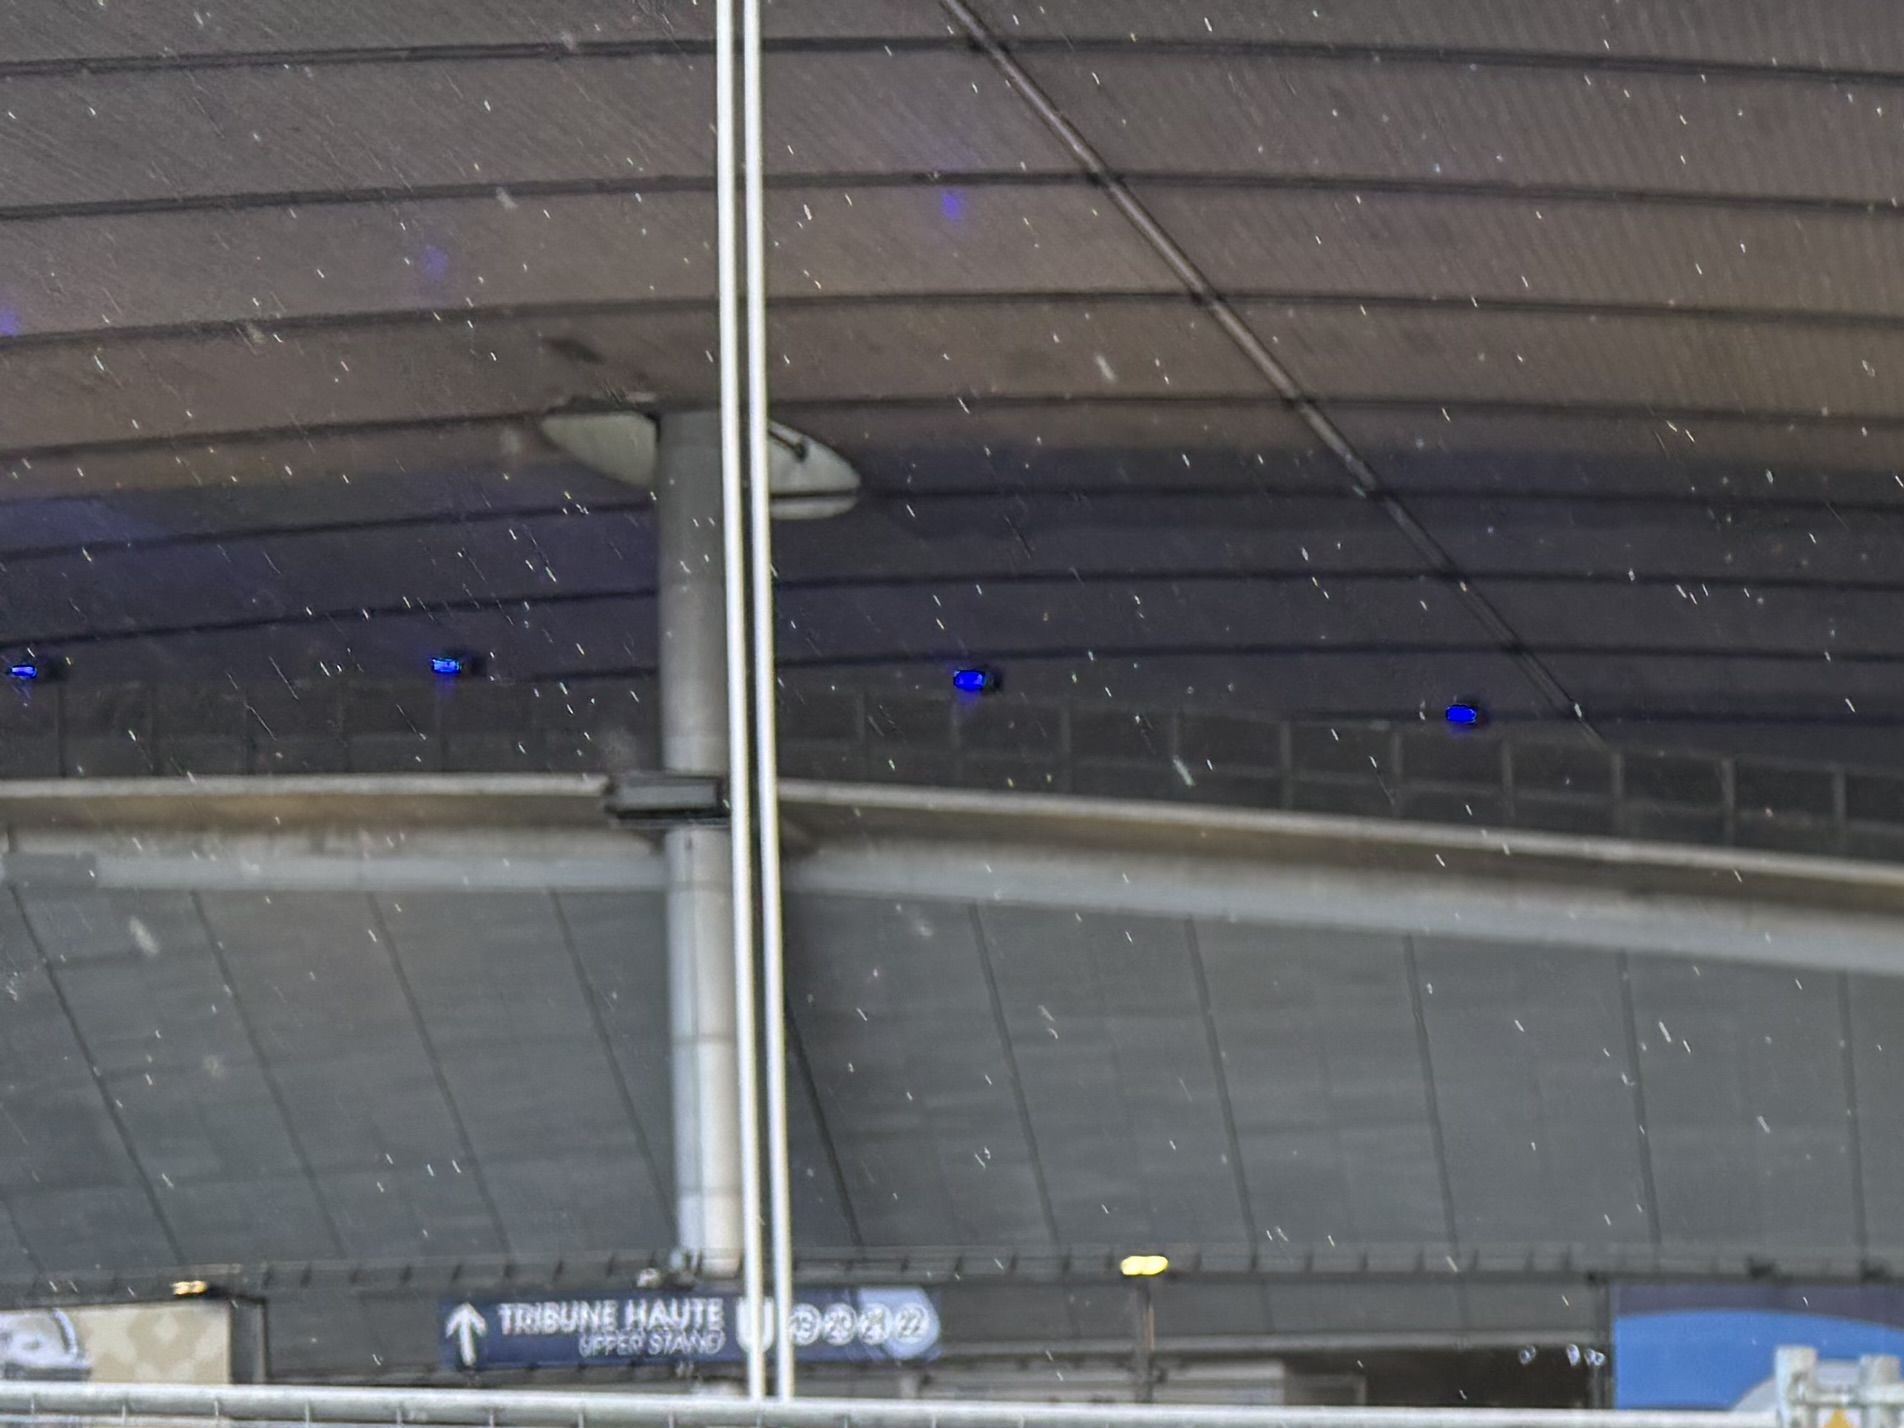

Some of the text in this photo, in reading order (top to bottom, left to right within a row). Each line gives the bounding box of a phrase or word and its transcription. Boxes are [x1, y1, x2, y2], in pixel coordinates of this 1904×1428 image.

[499, 1300, 618, 1335] TRIBUNE
[624, 1298, 725, 1331] HAUTE
[578, 1327, 727, 1358] UPPER STAND
